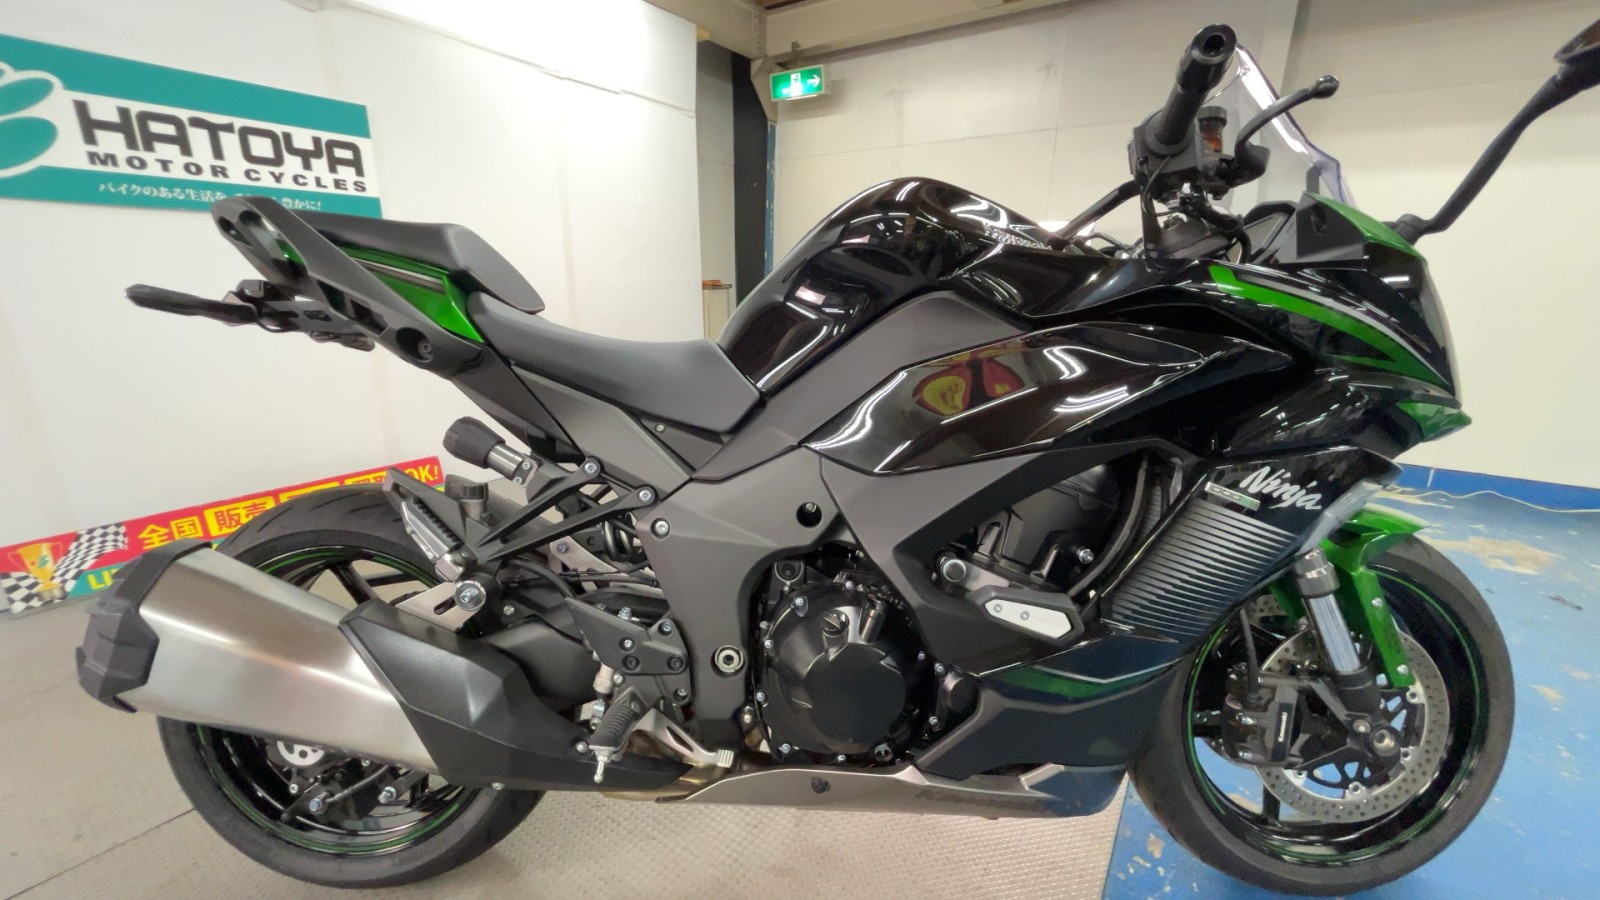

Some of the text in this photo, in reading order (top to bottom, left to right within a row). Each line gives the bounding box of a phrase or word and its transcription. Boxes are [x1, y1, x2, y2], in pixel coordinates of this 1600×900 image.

[73, 99, 365, 178] HATOYA
[86, 151, 367, 193] MOTOR CYCLES
[1239, 466, 1322, 510] Ninja
[138, 515, 204, 550] 全国
